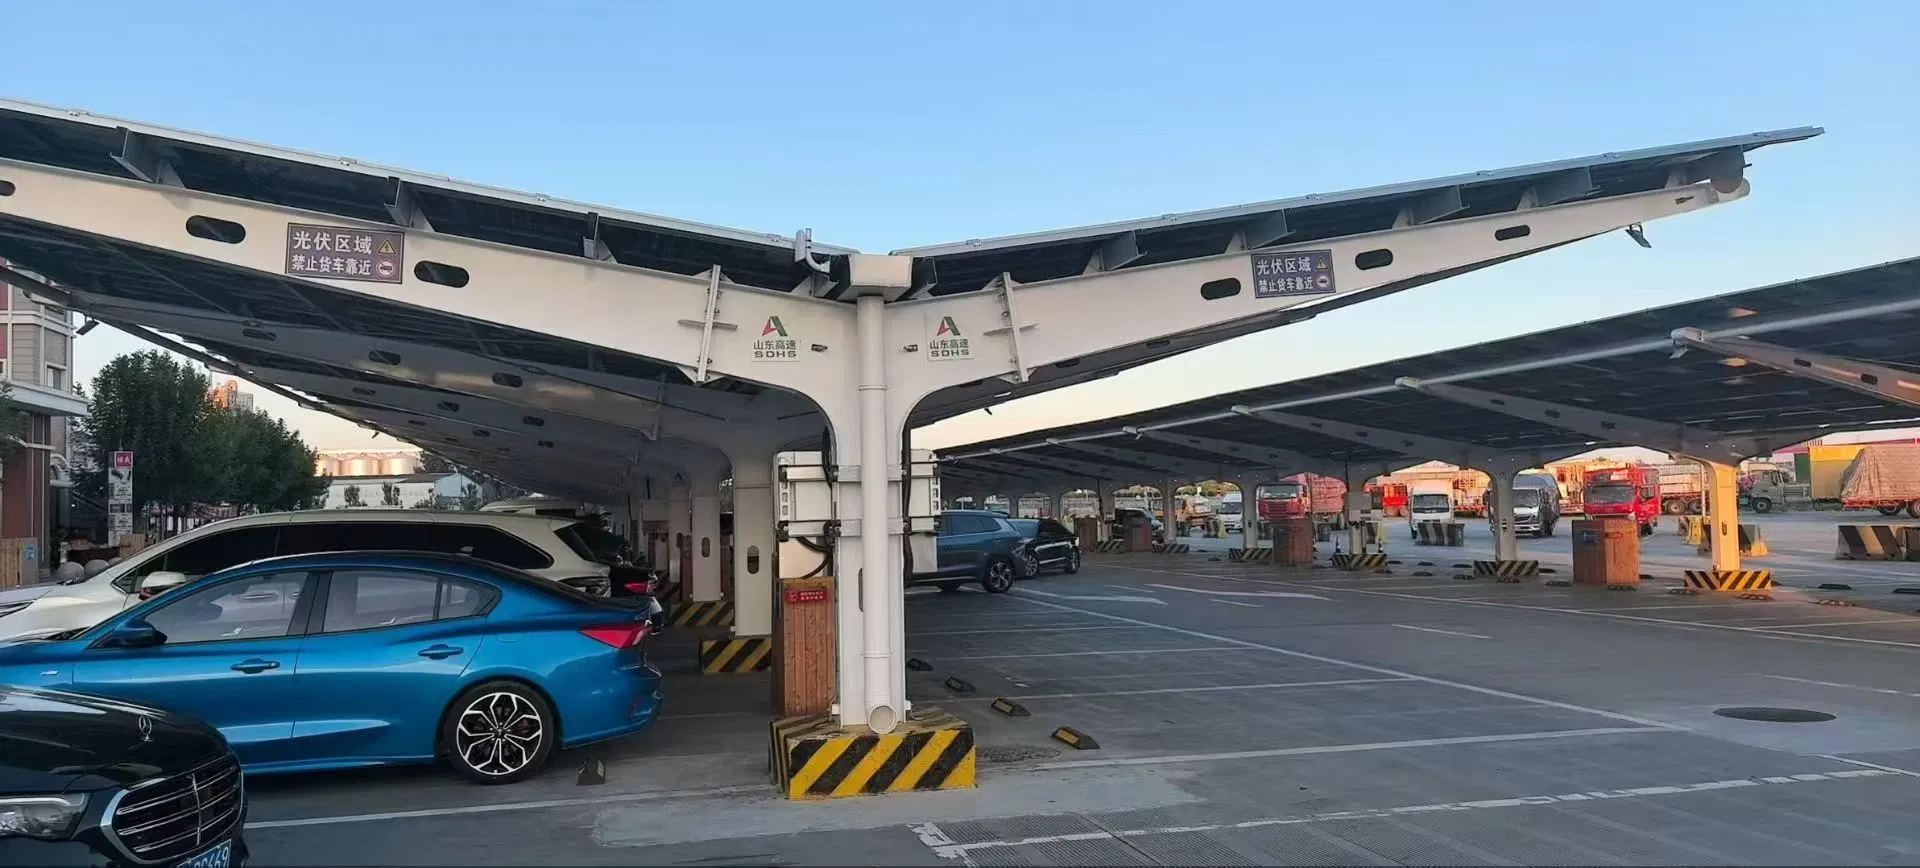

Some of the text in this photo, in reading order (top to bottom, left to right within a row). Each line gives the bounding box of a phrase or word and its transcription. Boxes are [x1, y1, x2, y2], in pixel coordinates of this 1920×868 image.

[293, 230, 373, 255] 光伏区域
[292, 254, 371, 276] 禁止货车靠近
[1257, 256, 1311, 275] 光伏区域
[1259, 276, 1314, 293] 禁止货车靠近
[753, 339, 796, 350] 山东高速
[929, 338, 969, 349] 山东高速
[754, 350, 797, 358] SDHS
[931, 348, 970, 357] SDHS
